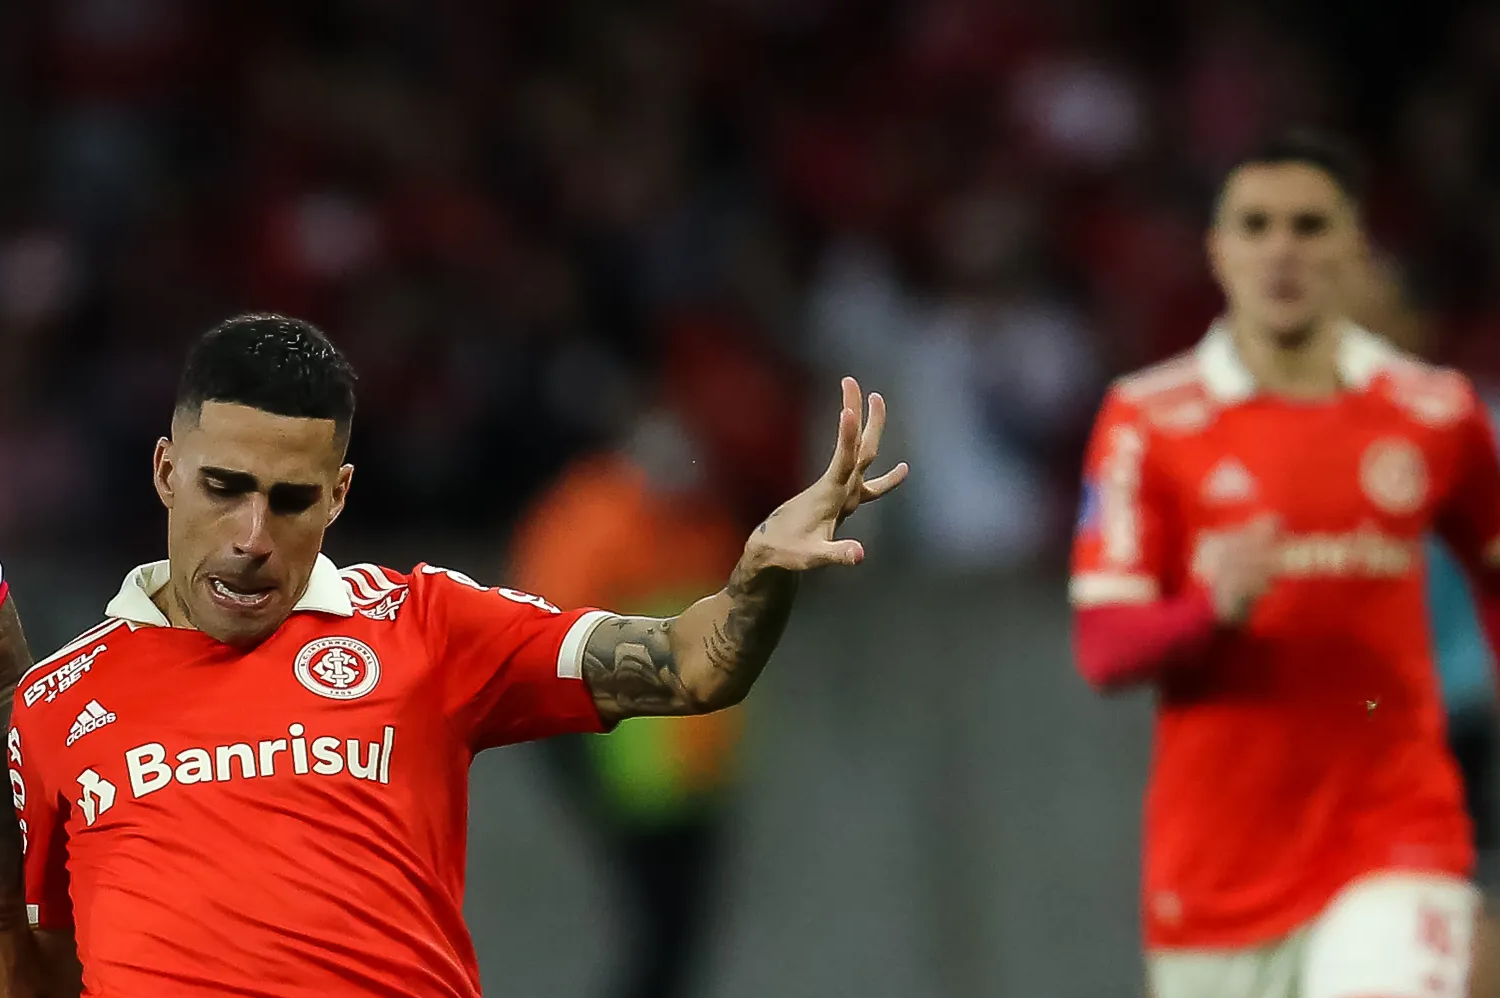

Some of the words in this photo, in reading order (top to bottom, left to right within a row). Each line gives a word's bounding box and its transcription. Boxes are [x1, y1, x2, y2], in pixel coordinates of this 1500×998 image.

[23, 644, 108, 707] ESTRELA
[58, 659, 94, 692] BET
[66, 712, 116, 747] adidas
[125, 723, 395, 799] Banrisul
